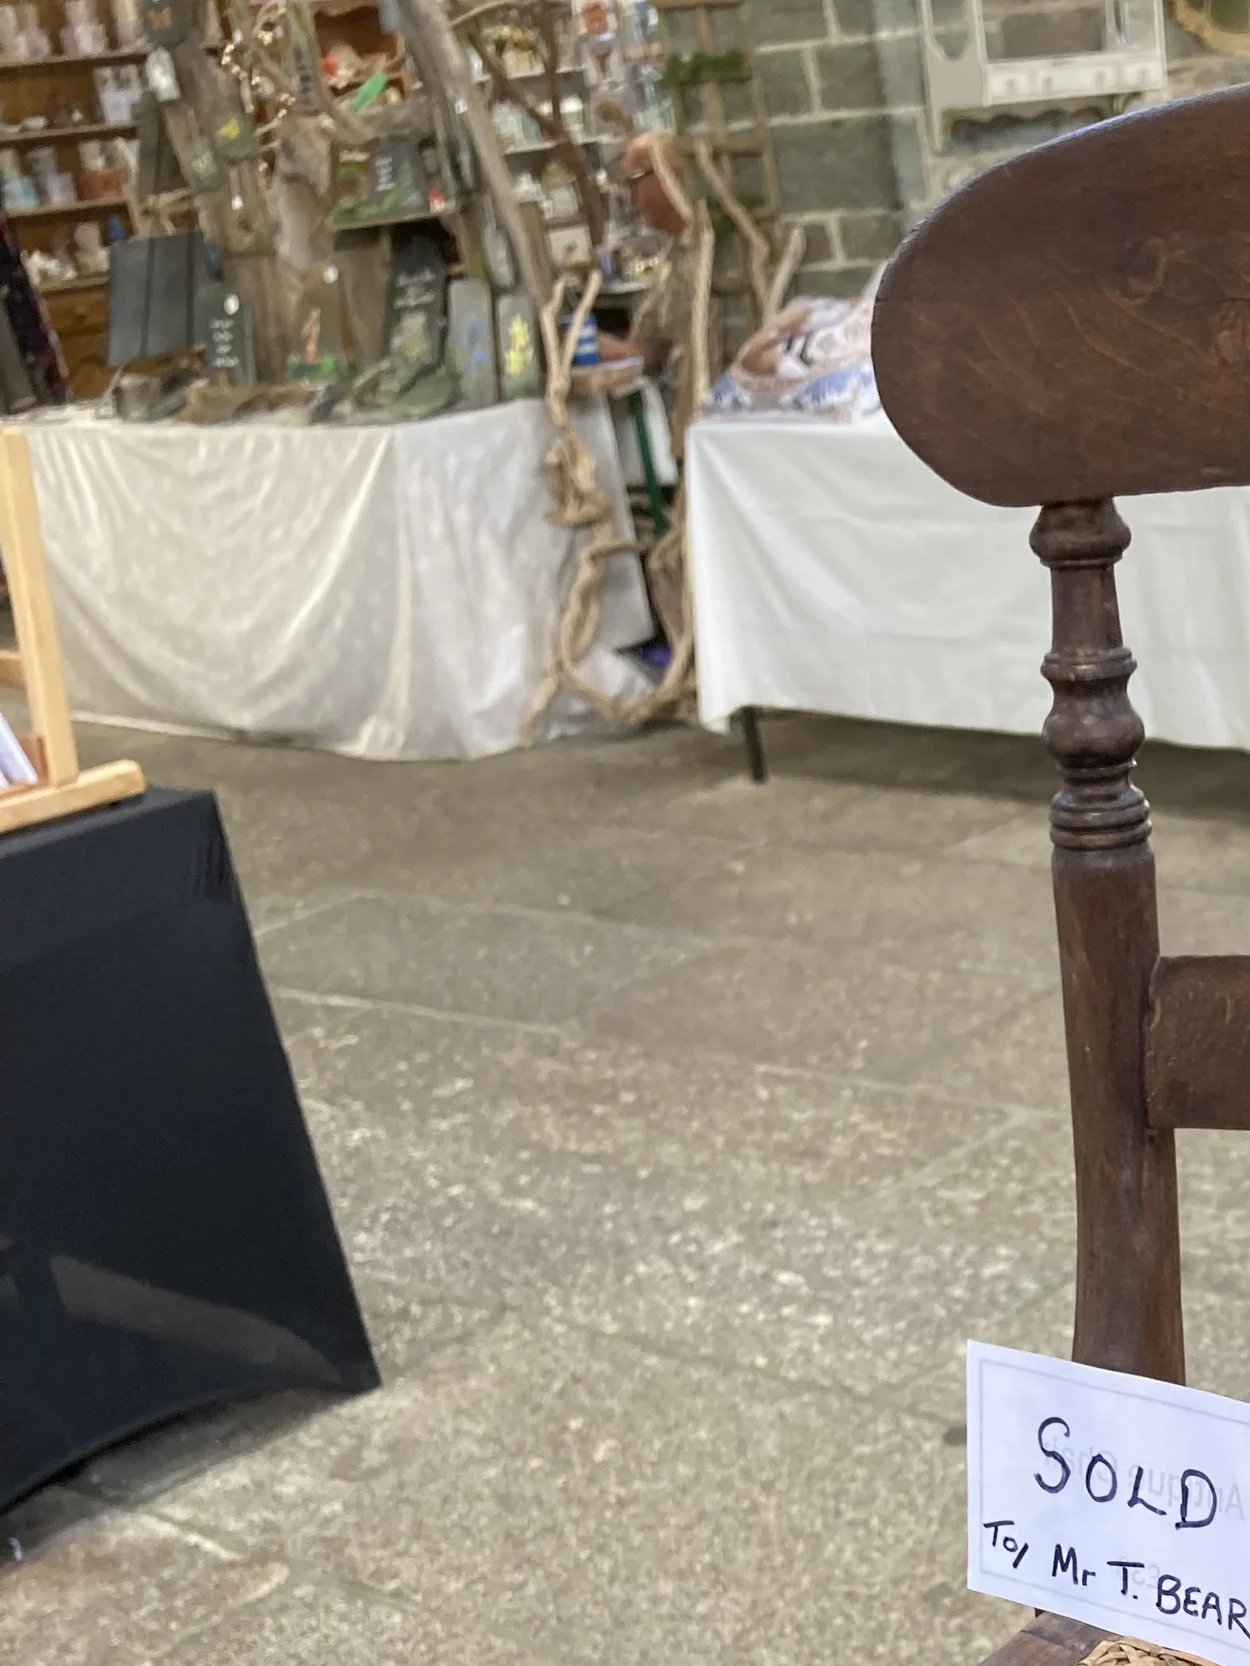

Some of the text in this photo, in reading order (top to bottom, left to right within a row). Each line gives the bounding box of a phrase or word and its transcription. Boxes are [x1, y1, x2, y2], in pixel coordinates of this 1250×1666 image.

[1033, 1416, 1218, 1530] SOLD
[1051, 1543, 1096, 1586] Mr
[1106, 1559, 1145, 1600] T.
